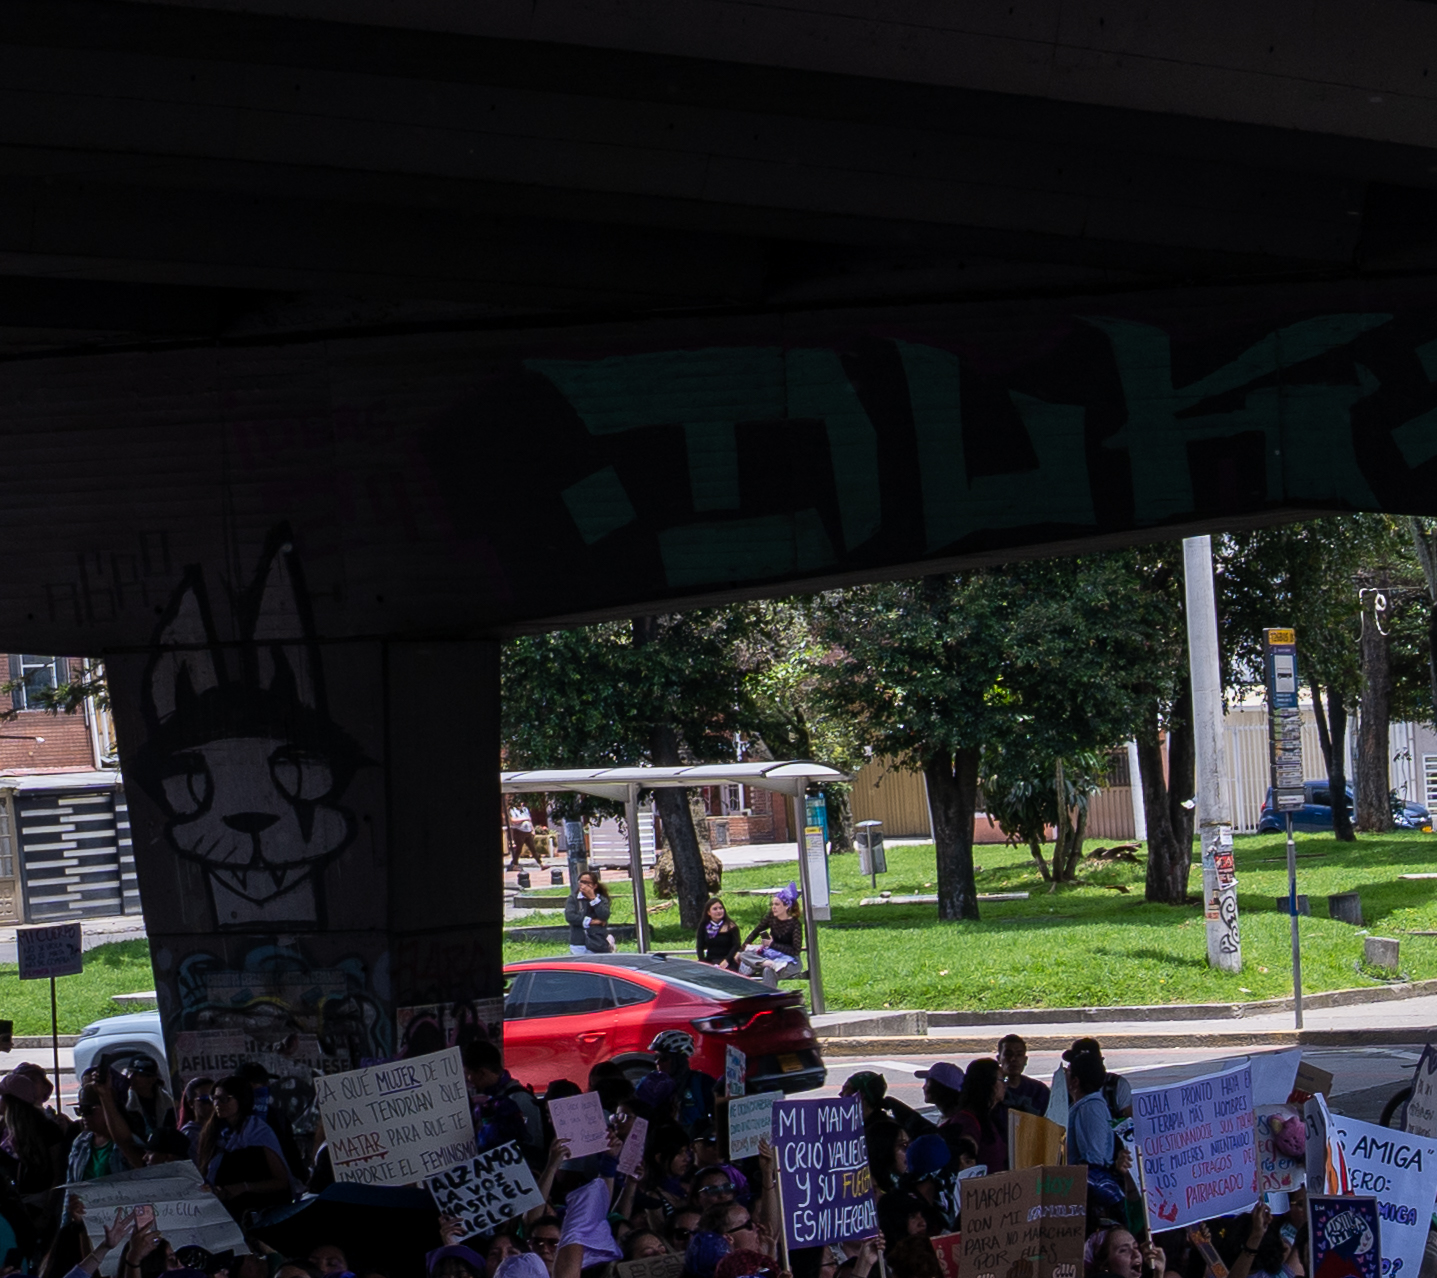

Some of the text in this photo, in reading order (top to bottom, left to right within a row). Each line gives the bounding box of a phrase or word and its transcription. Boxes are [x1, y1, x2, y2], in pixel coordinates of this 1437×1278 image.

[324, 1080, 466, 1132] VIDA TENDRÍAN QUE
[331, 1110, 468, 1161] MATAR PARA QUE TE
[964, 1225, 1083, 1257] PARA NO MARCHAR
